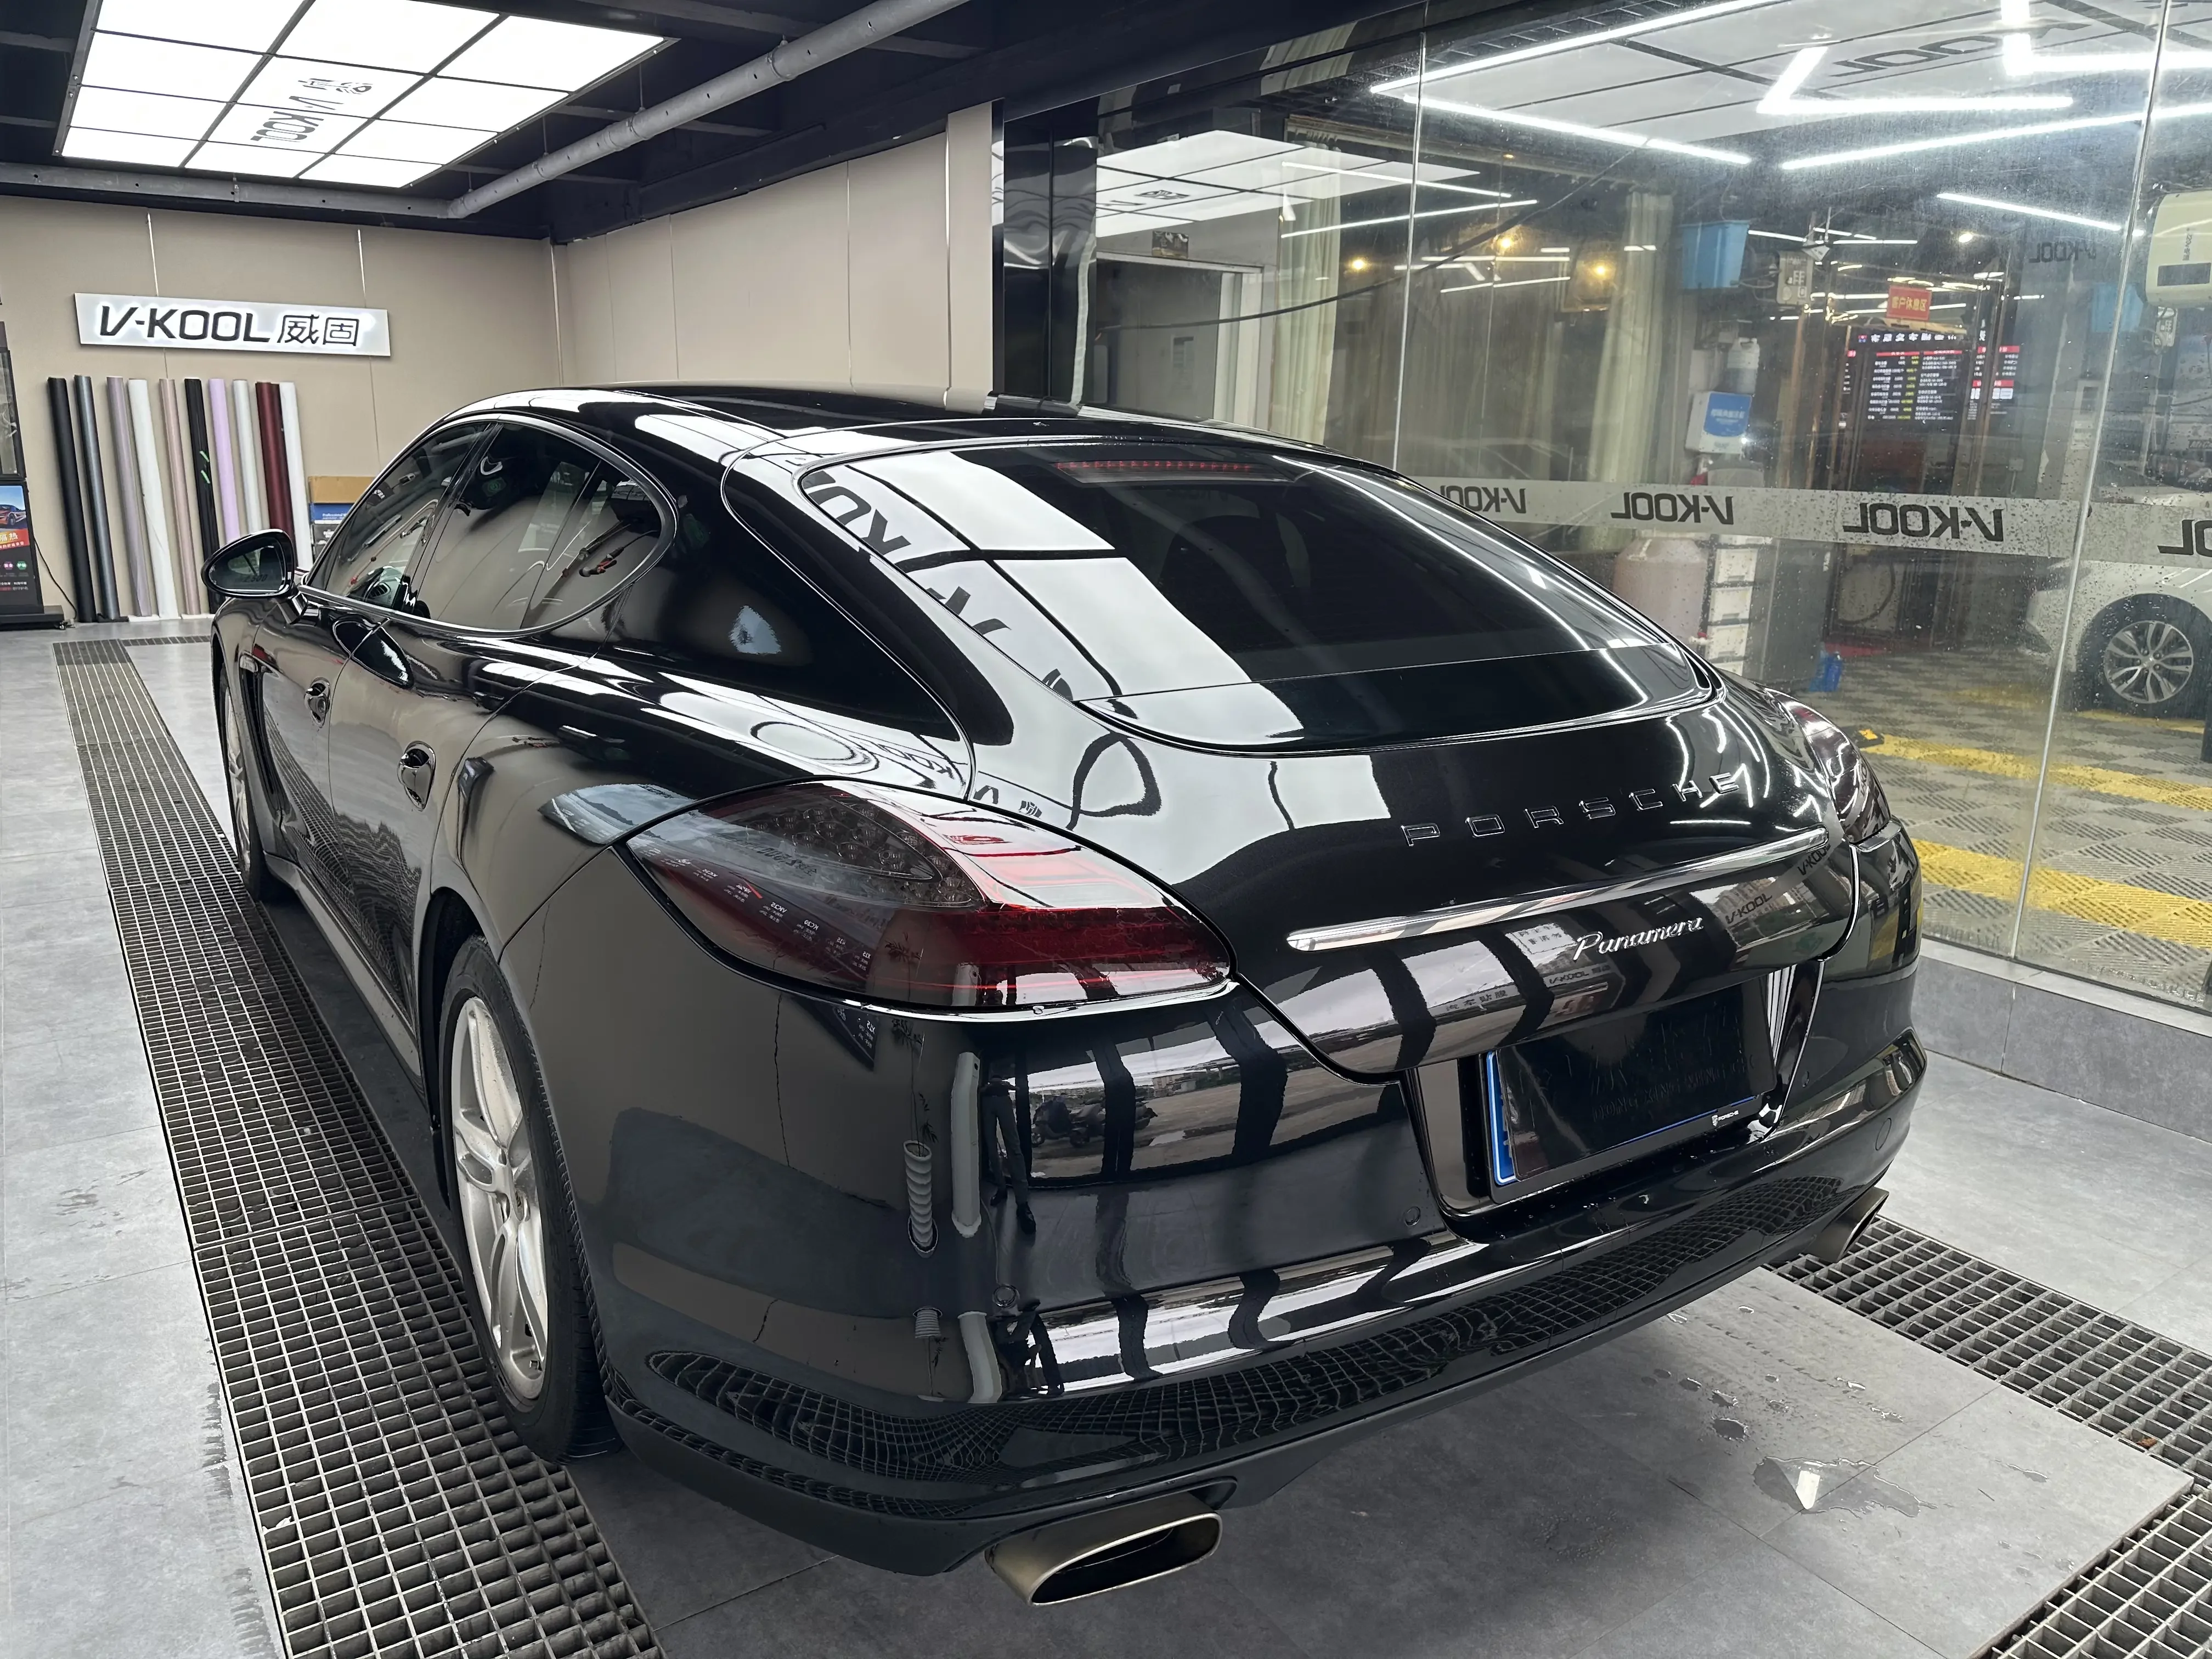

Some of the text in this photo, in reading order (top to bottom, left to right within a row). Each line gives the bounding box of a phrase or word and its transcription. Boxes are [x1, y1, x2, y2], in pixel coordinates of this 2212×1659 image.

[100, 305, 360, 347] V-KOOL 威固
[1401, 772, 1740, 848] PORSCHE
[1573, 917, 1704, 964] Panamera
